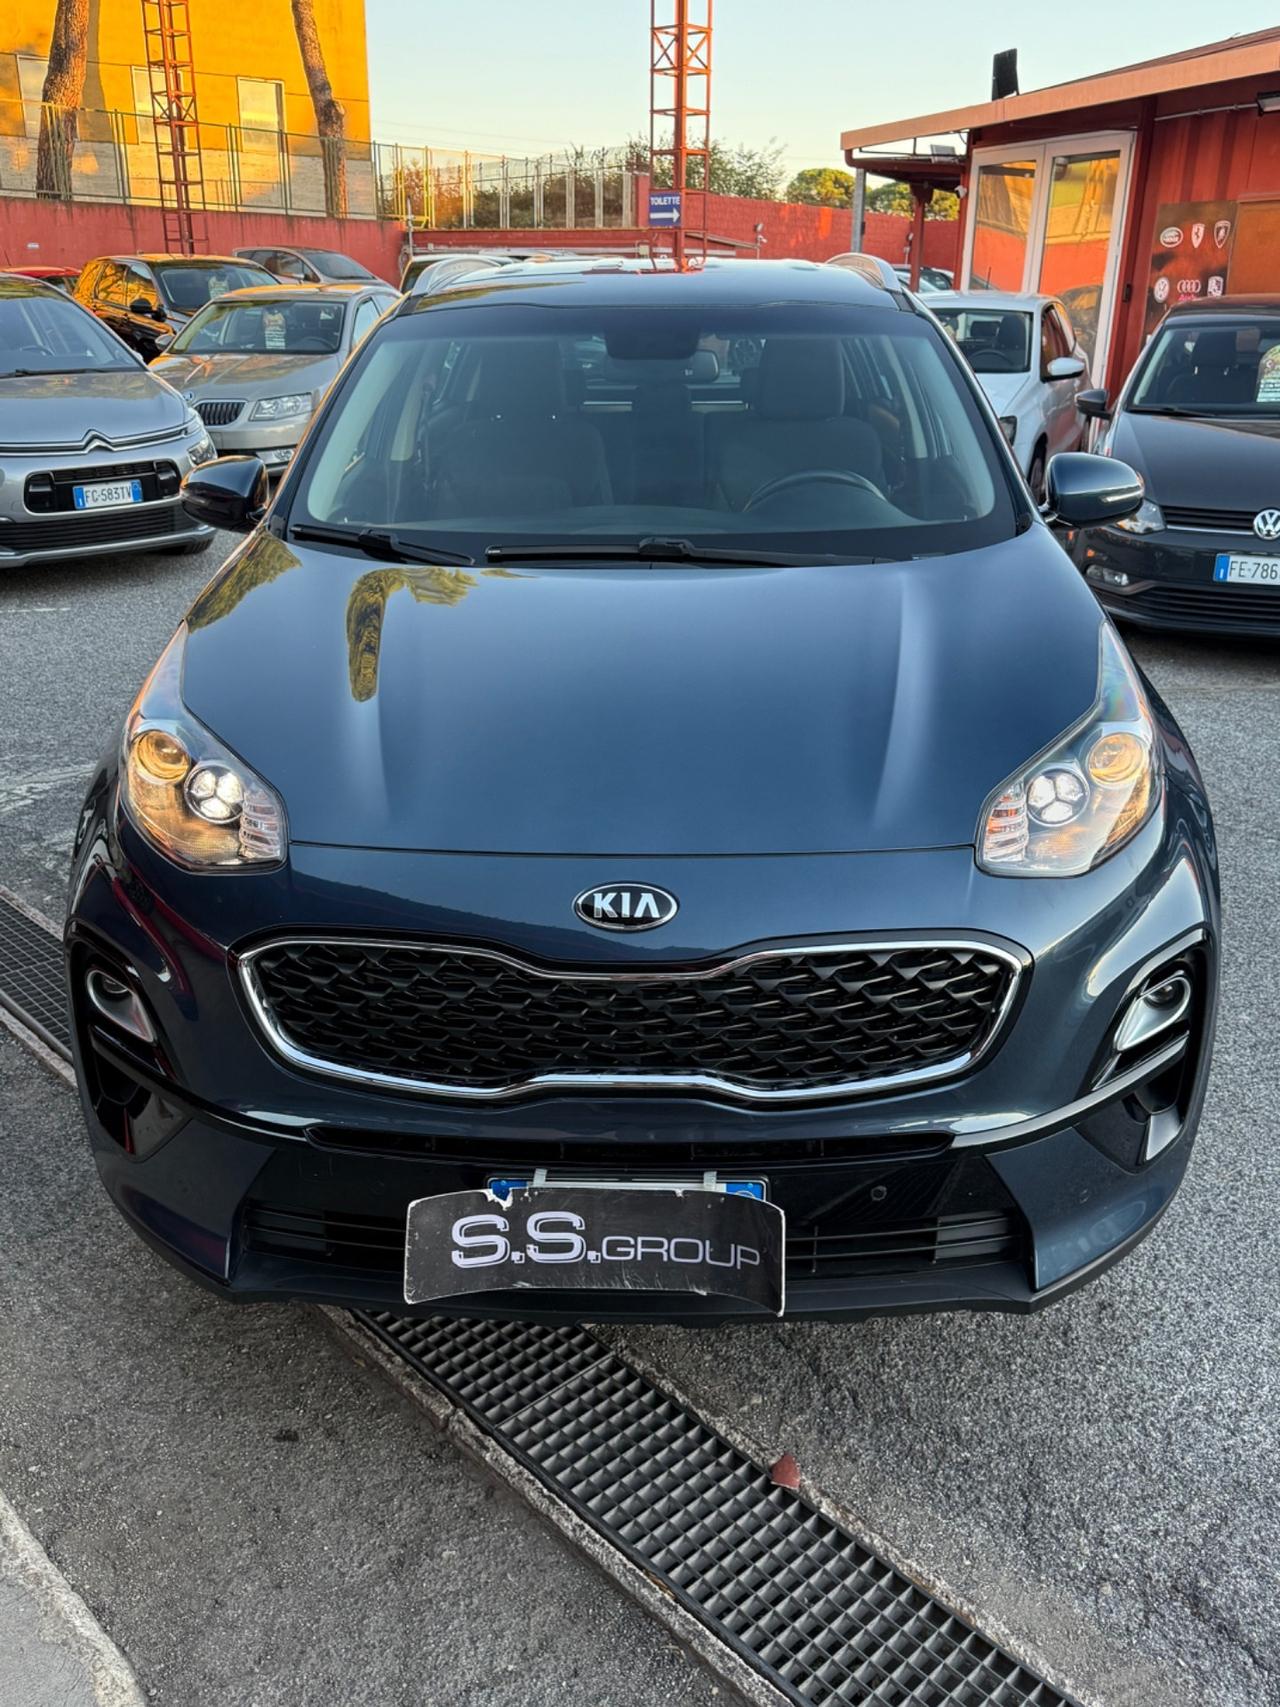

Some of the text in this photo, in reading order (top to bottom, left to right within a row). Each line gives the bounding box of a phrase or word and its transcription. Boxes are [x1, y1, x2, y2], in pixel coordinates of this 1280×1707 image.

[650, 196, 680, 206] TOILETTE
[1229, 561, 1280, 580] FE-786
[593, 892, 660, 918] KIA
